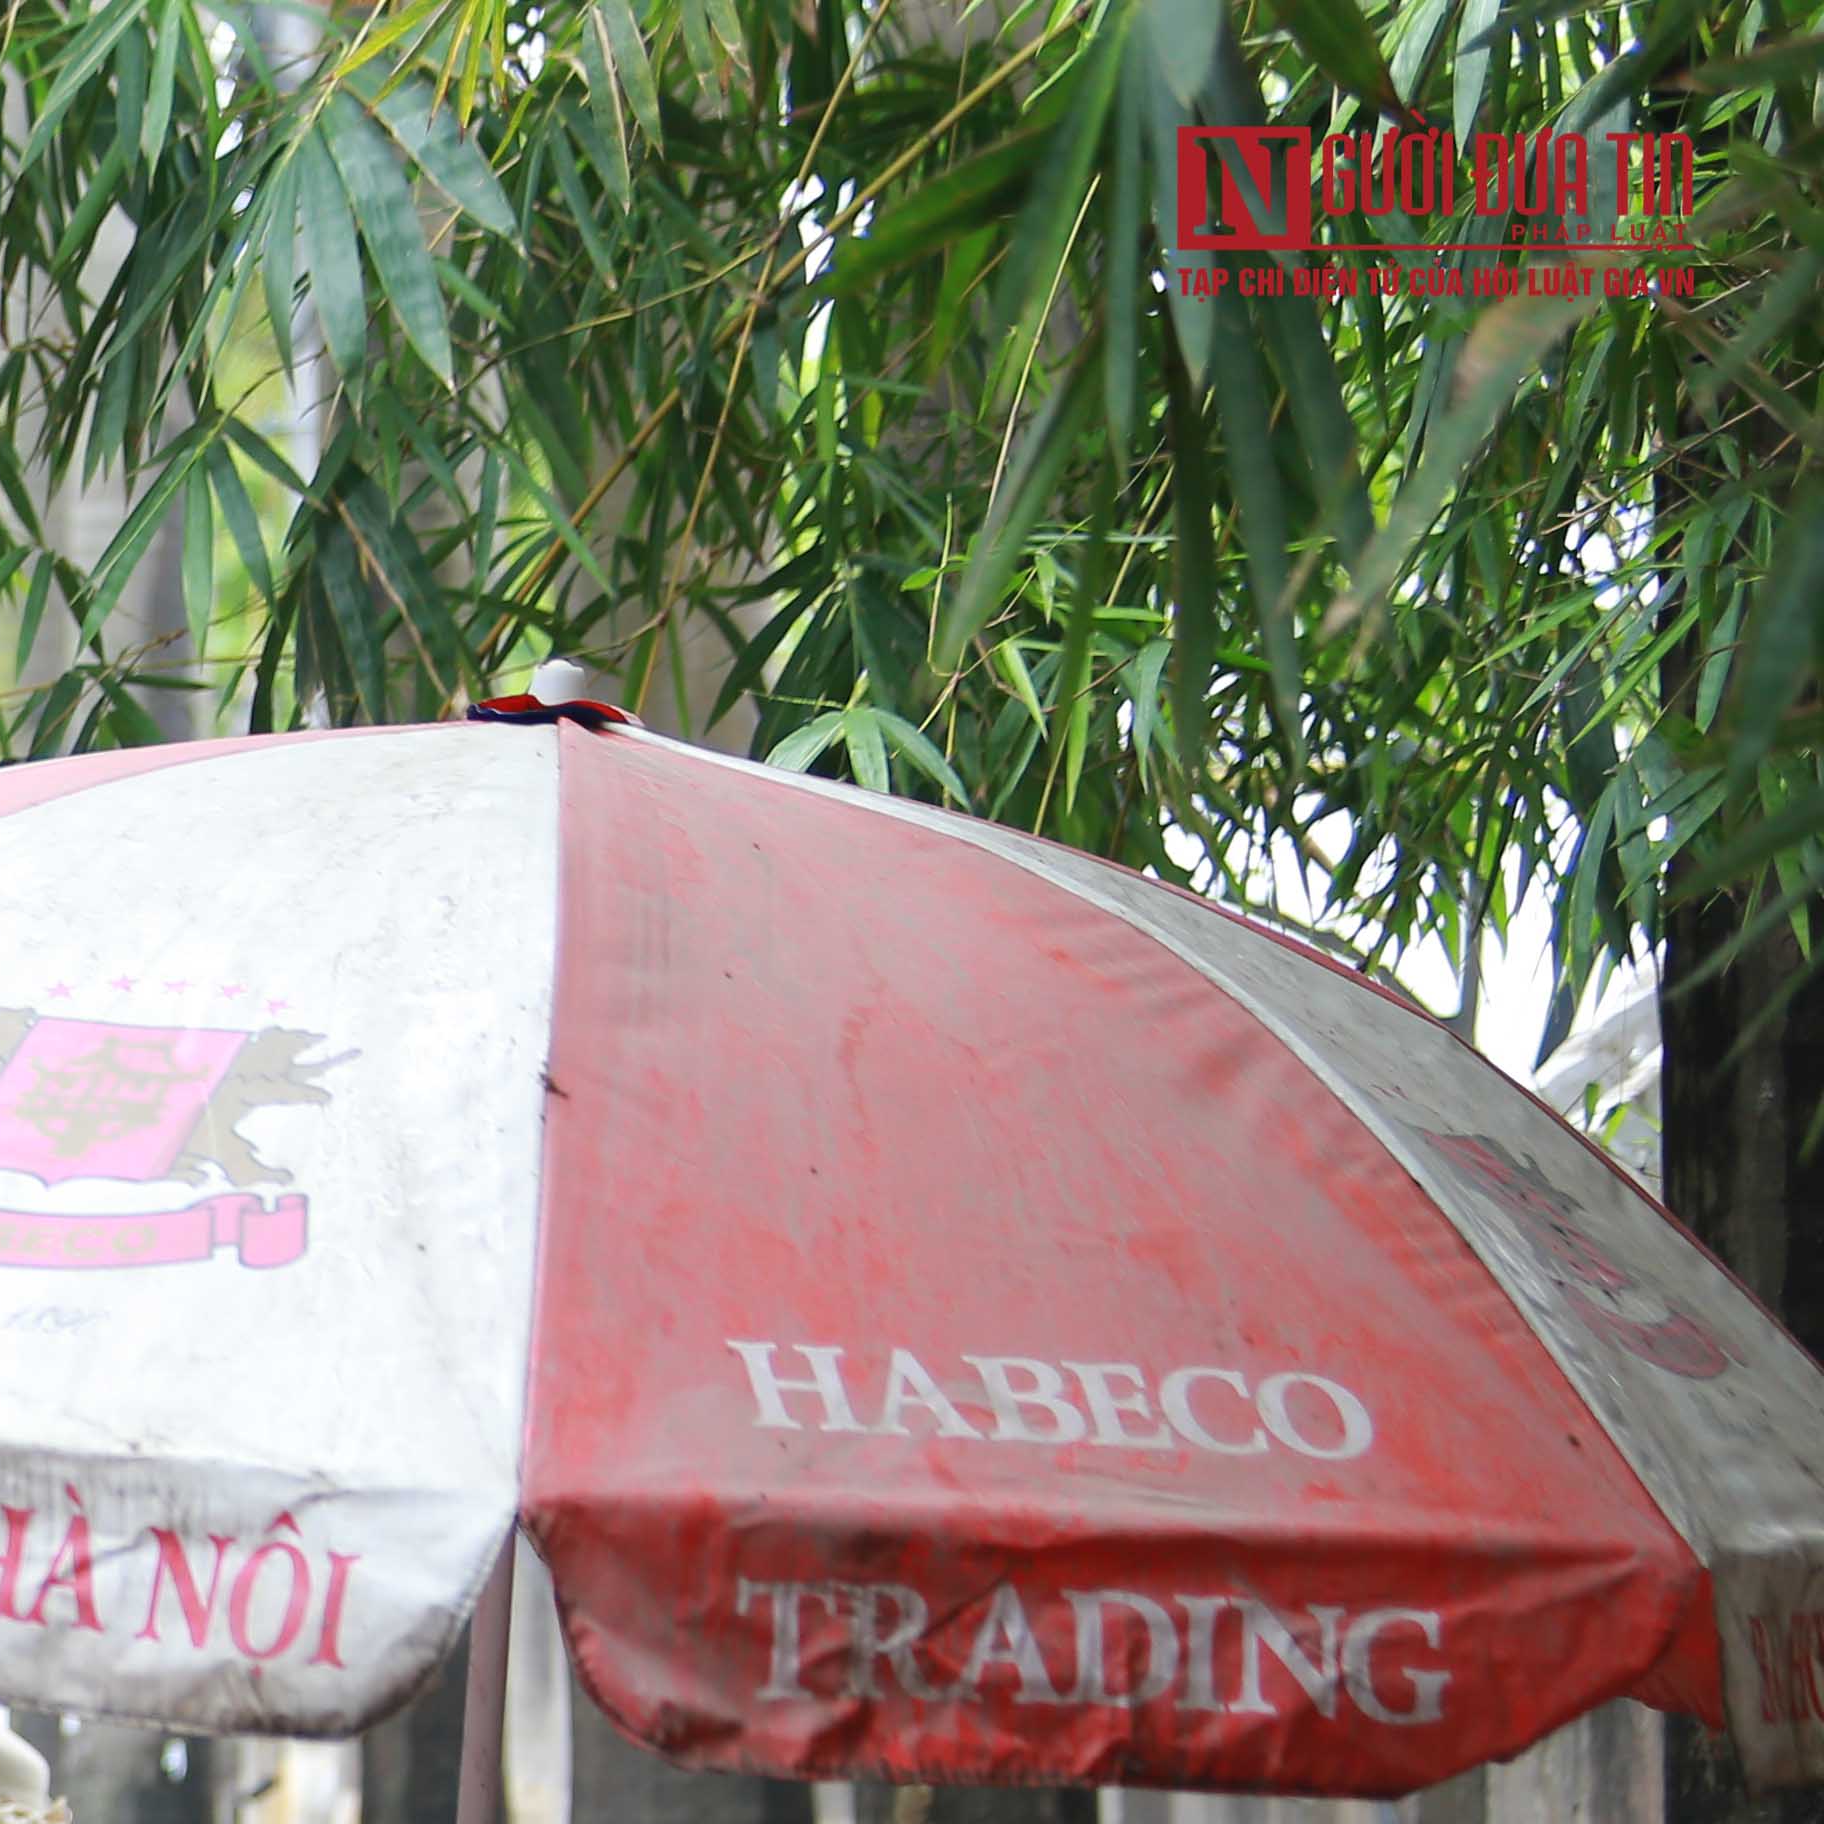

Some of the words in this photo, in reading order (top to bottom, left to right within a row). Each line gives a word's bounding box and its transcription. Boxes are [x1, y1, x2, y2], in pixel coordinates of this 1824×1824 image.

[727, 1339, 1376, 1462] HABECO
[138, 1509, 360, 1678] NỘI
[736, 1576, 1452, 1726] TRADING
